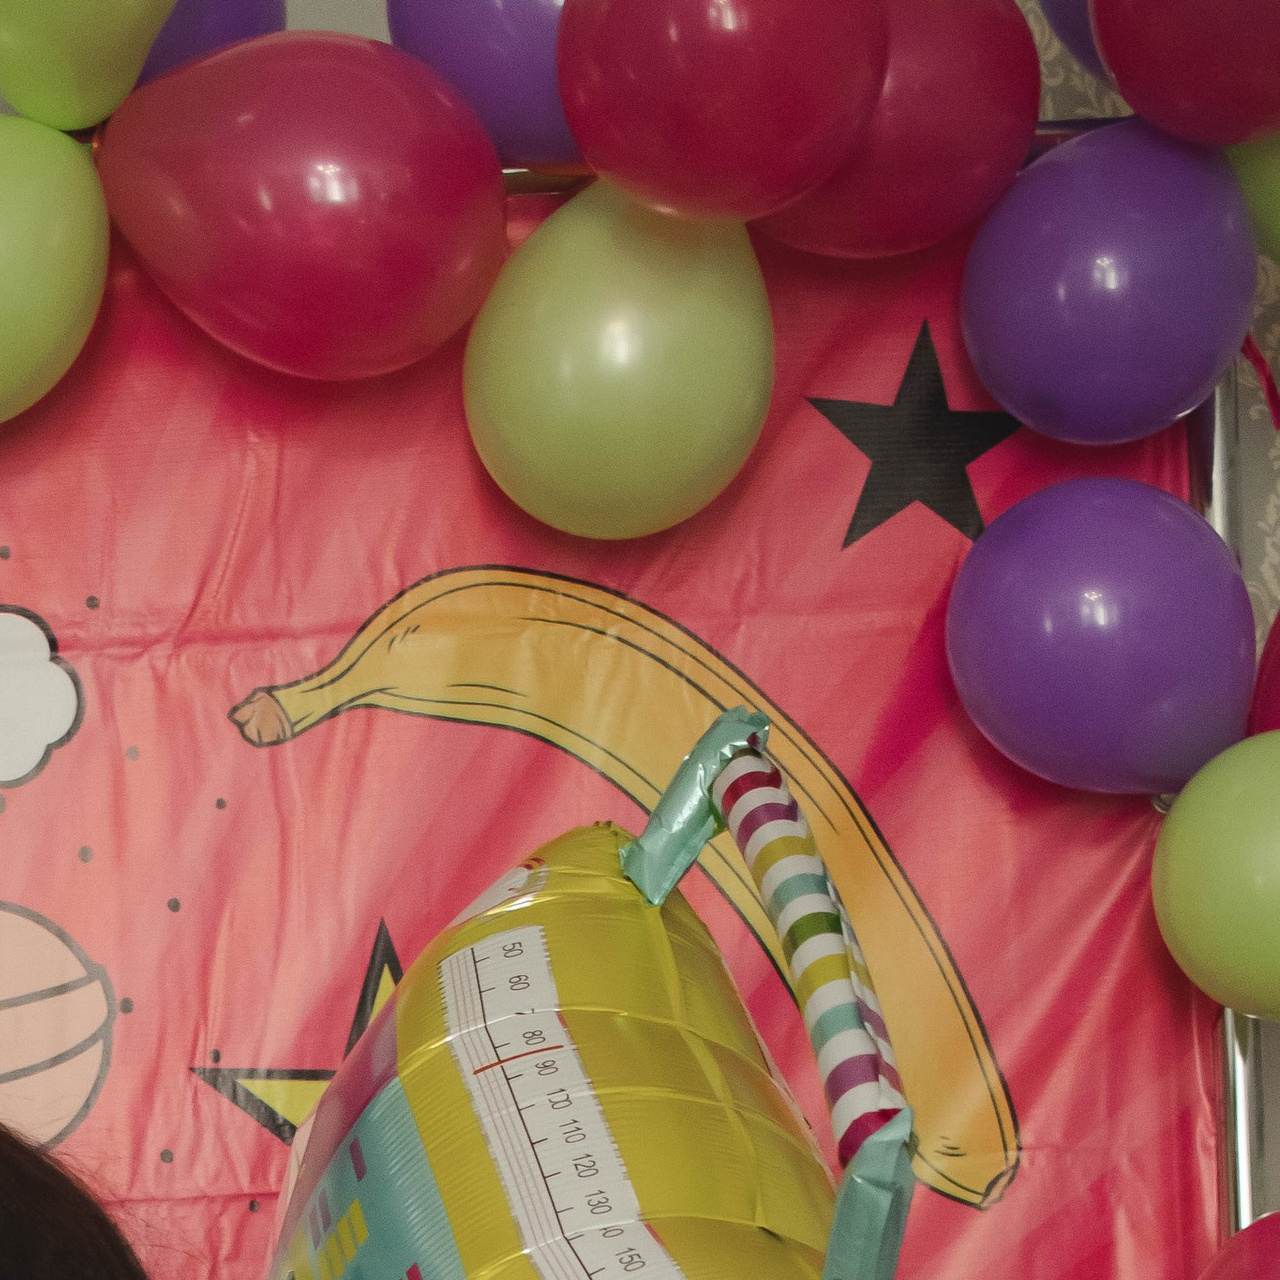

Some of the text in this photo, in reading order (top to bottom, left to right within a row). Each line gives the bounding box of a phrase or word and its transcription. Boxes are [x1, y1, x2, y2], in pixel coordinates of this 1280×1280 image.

[502, 941, 524, 959] 50
[508, 974, 530, 991] 60
[522, 1029, 546, 1046] 80
[535, 1059, 559, 1076] 90
[559, 1118, 587, 1144] 110
[572, 1153, 599, 1178] 120
[584, 1189, 612, 1215] 130
[615, 1246, 646, 1272] 150
